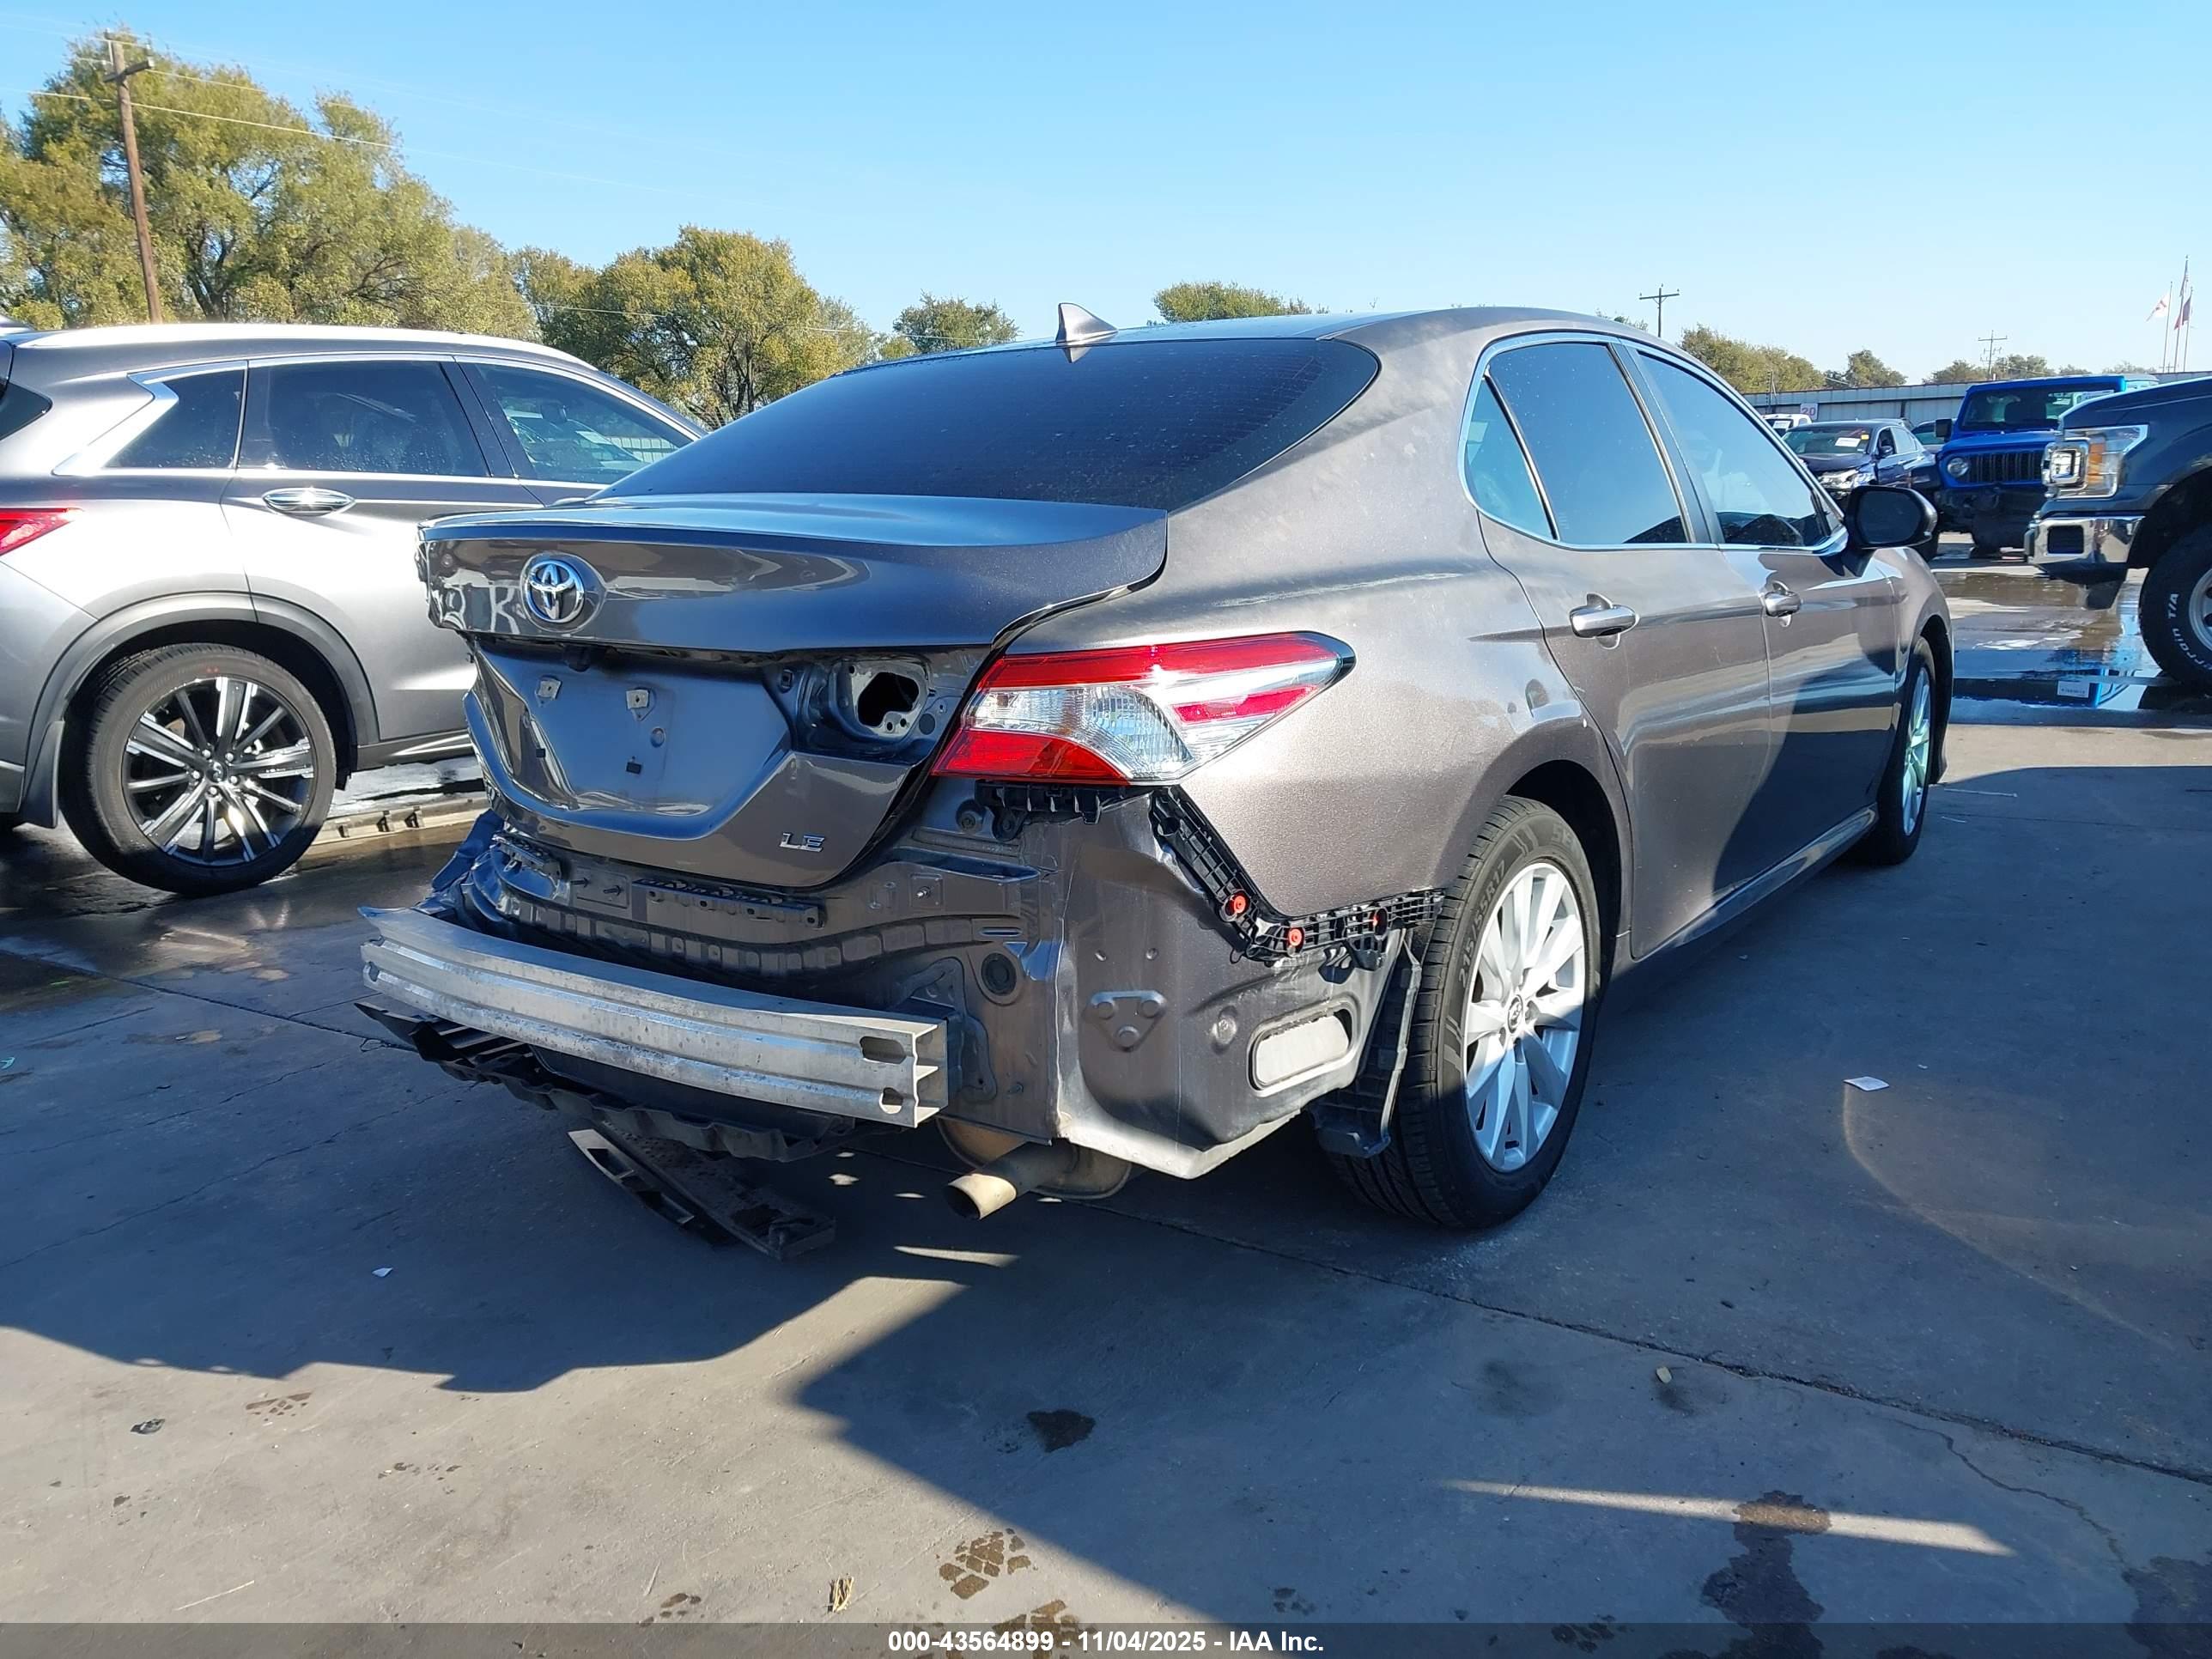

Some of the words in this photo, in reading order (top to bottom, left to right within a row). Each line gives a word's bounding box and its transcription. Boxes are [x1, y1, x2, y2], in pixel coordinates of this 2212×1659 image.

[1802, 407, 1817, 416] 20
[2168, 592, 2179, 618] T/A
[779, 832, 825, 853] LE
[1459, 860, 1505, 988] 215/55R17
